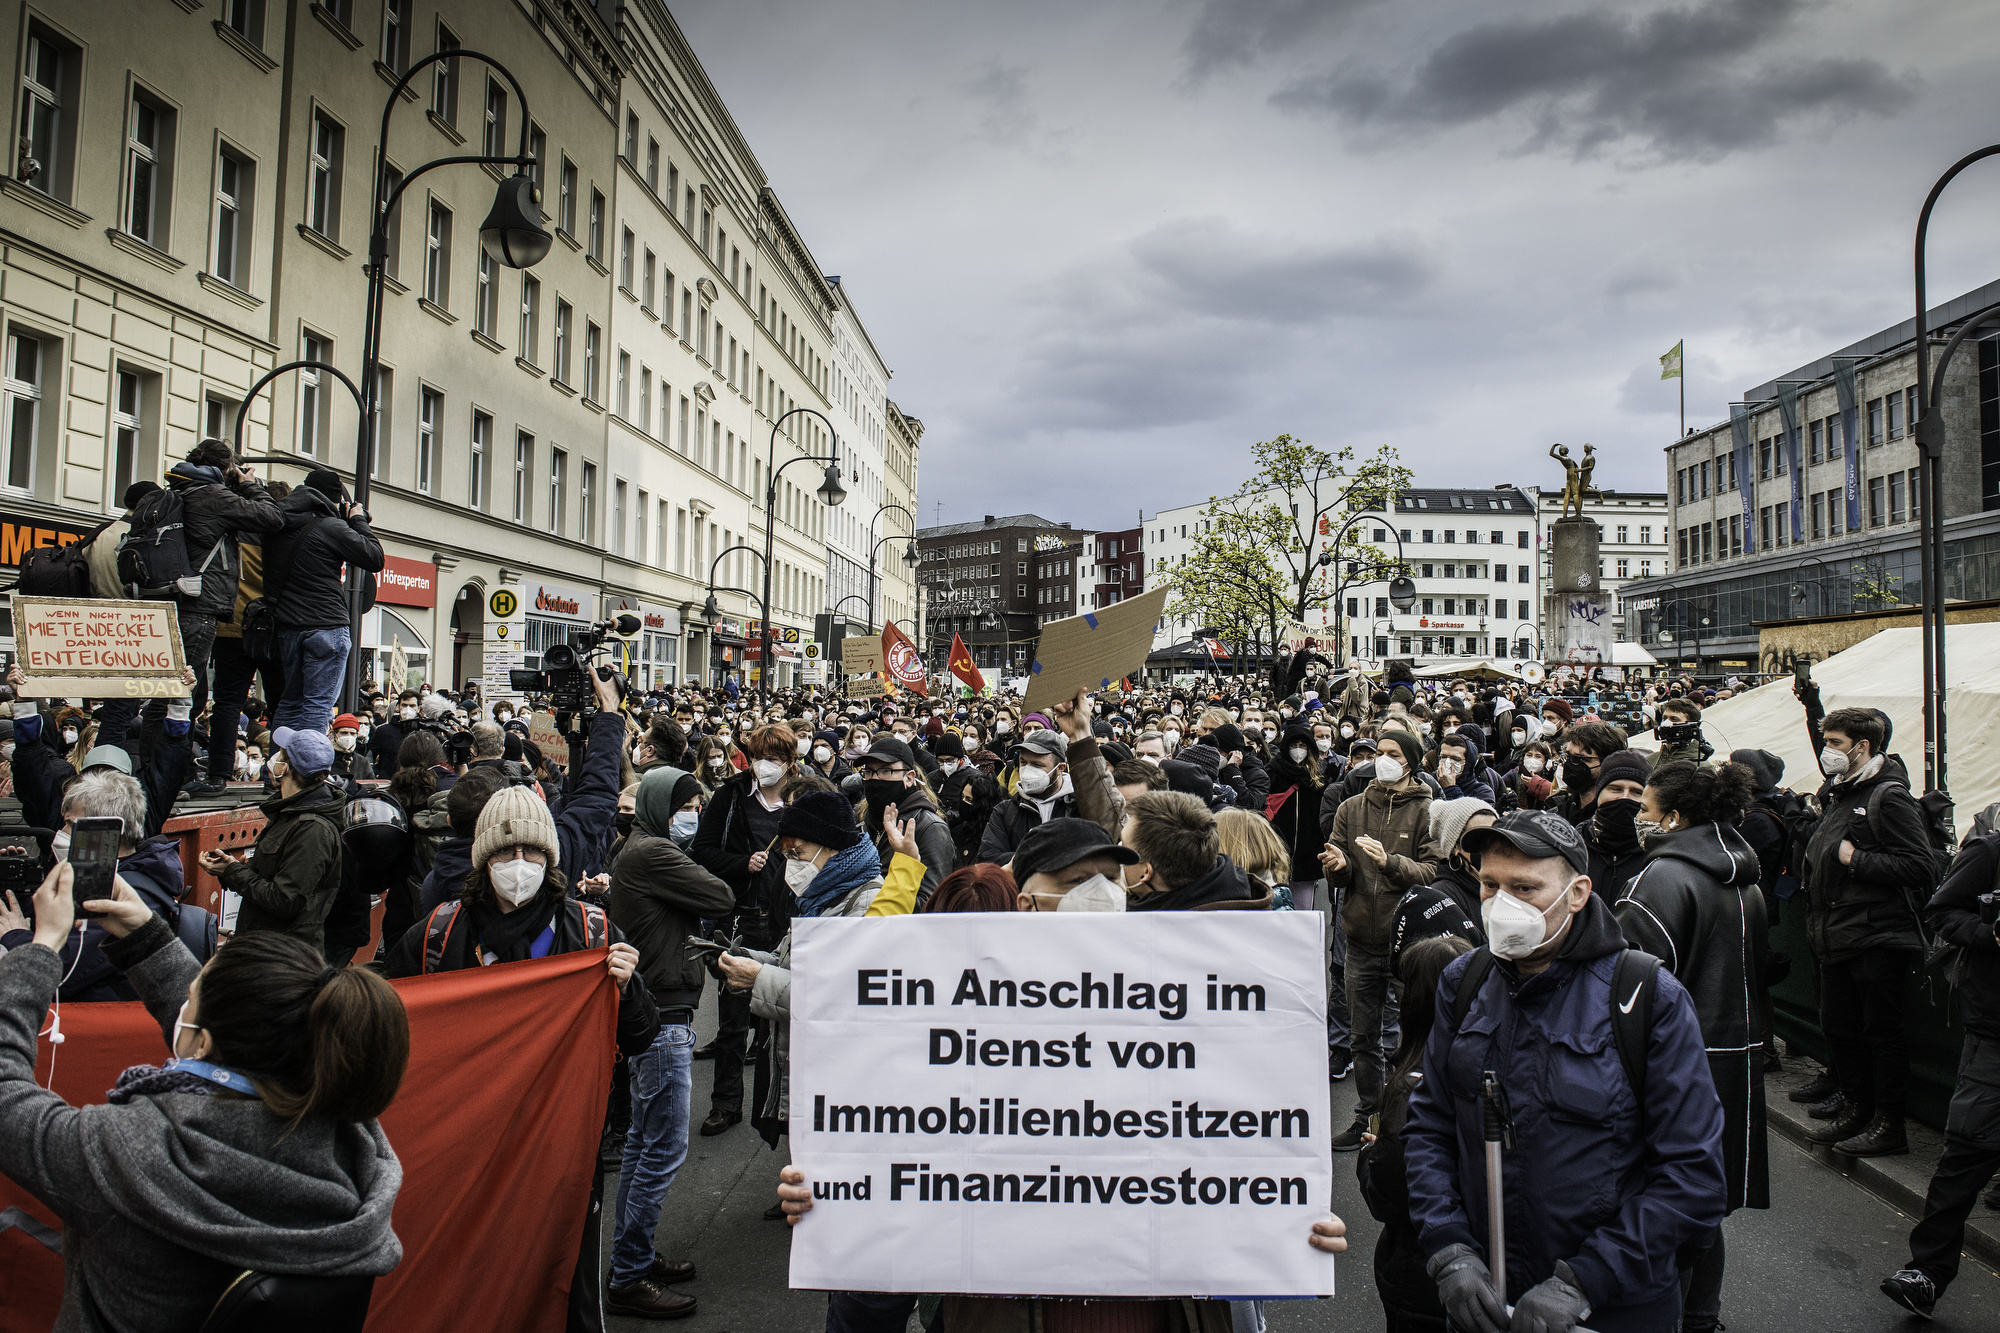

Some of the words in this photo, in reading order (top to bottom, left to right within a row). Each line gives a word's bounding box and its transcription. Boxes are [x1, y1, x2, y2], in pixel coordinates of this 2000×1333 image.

[383, 568, 430, 590] Hörexperten
[496, 596, 510, 611] H
[545, 593, 580, 615] Santander
[45, 610, 80, 618] WENN
[89, 611, 122, 620] NICHT
[130, 613, 155, 621] MIT
[644, 612, 665, 628] antander
[28, 621, 164, 638] MIETENDECKEL
[1431, 621, 1465, 629] Sparkasse
[65, 639, 107, 647] DANN
[115, 639, 142, 647] MIT
[31, 650, 170, 668] ENTEIGNUNG
[125, 679, 183, 696] SDAJ
[533, 732, 565, 747] DOCH
[857, 969, 935, 1006] Ein
[951, 968, 1188, 1021] Anschlag
[1207, 974, 1266, 1012] im
[928, 1028, 1092, 1068] Dienst
[1107, 1041, 1196, 1069] von
[813, 1094, 1310, 1139] Immobilienbesitzern
[813, 1175, 872, 1201] und
[890, 1163, 1308, 1205] Finanzinvestoren
